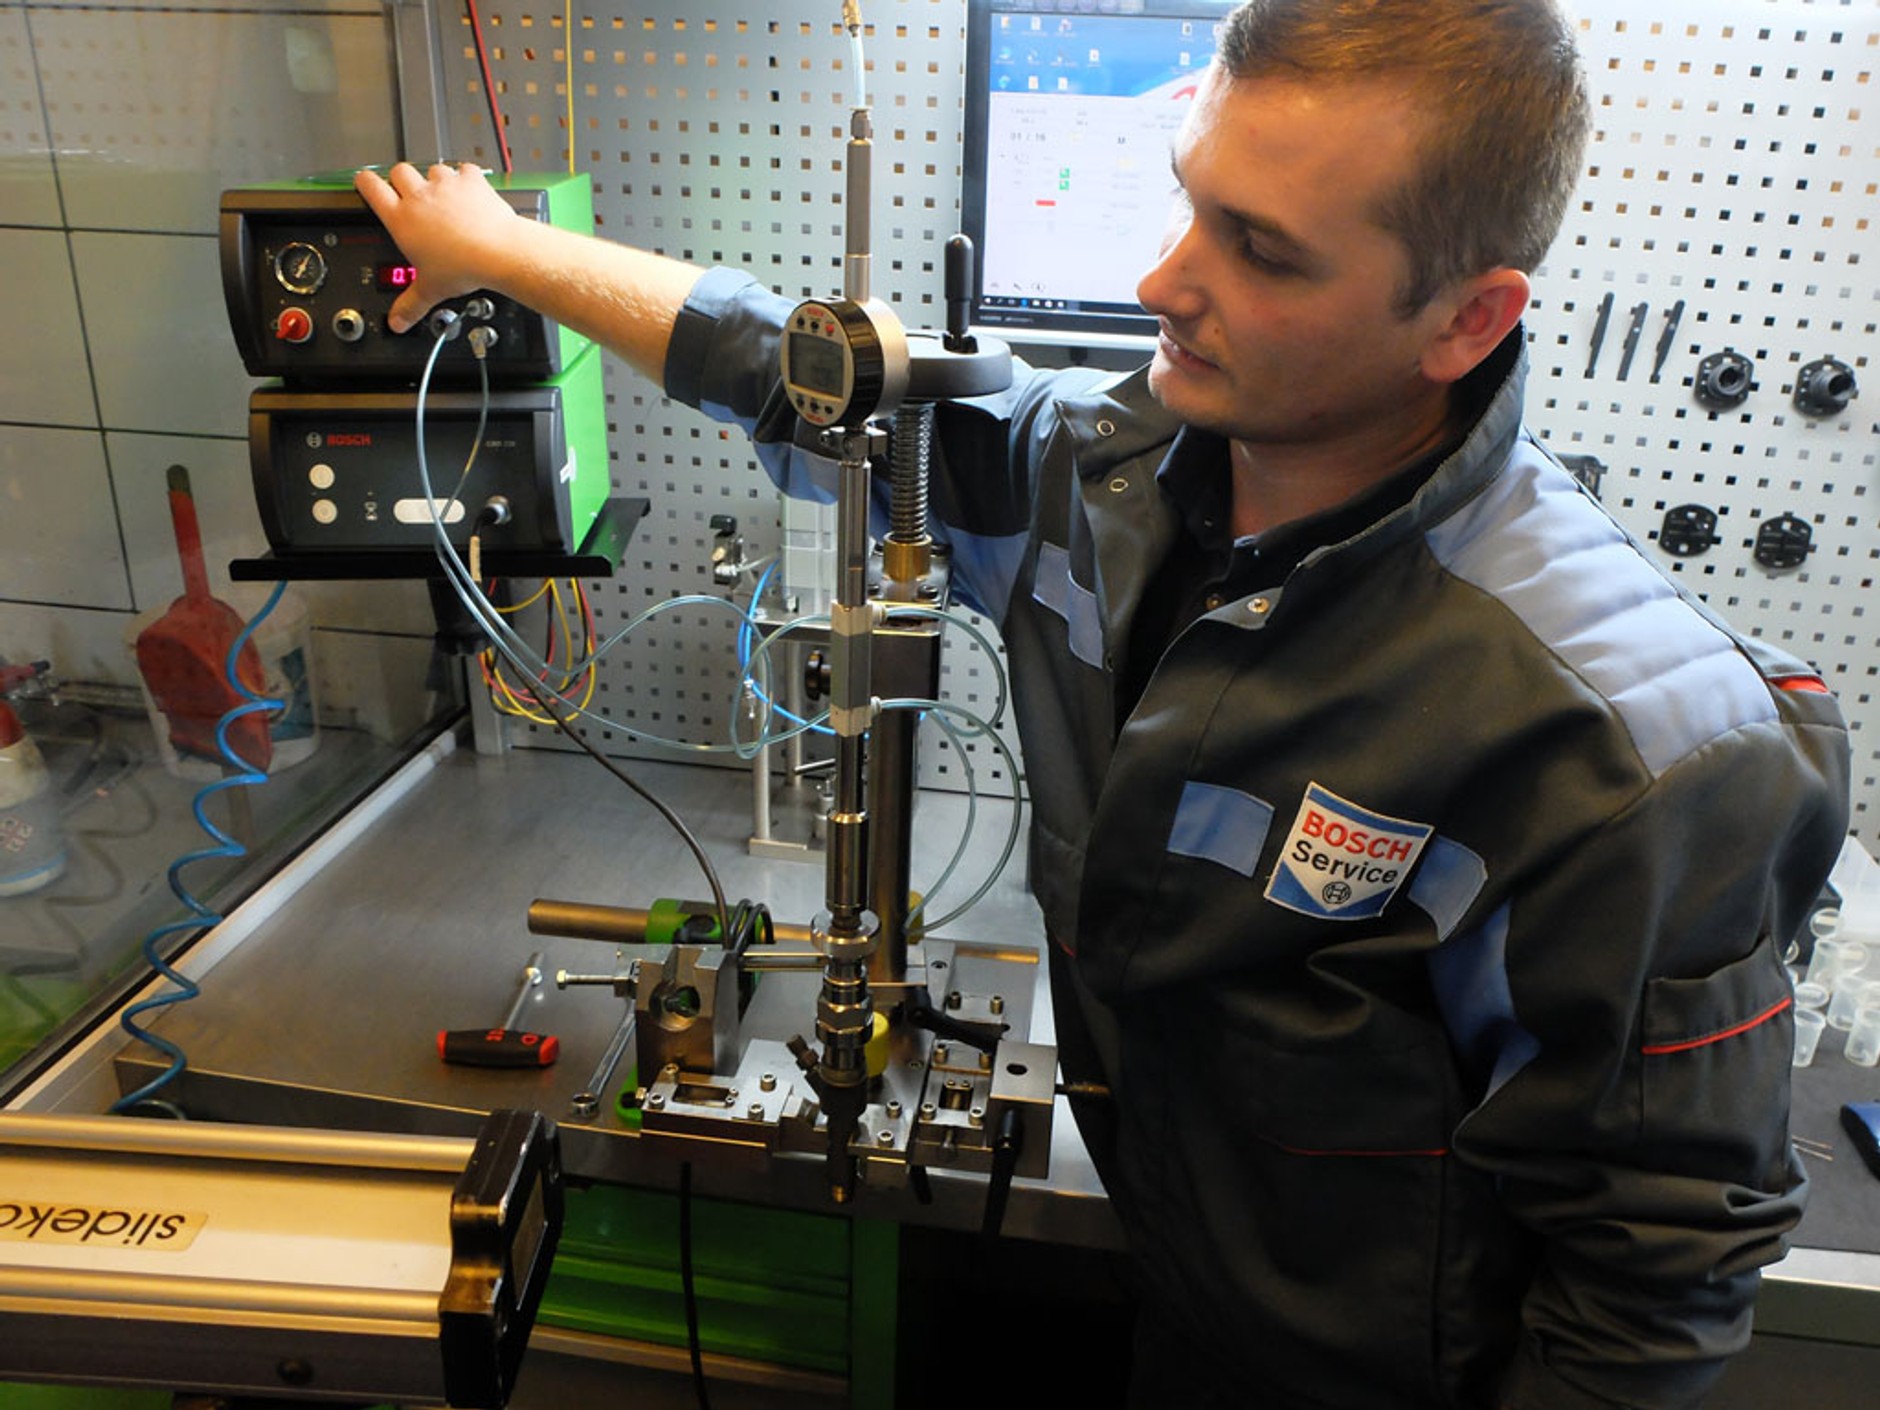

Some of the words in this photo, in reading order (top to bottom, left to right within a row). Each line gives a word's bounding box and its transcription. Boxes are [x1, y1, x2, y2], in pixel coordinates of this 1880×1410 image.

[326, 433, 372, 447] BOSCH
[1302, 809, 1413, 863] BOSCH
[1291, 839, 1399, 884] Service
